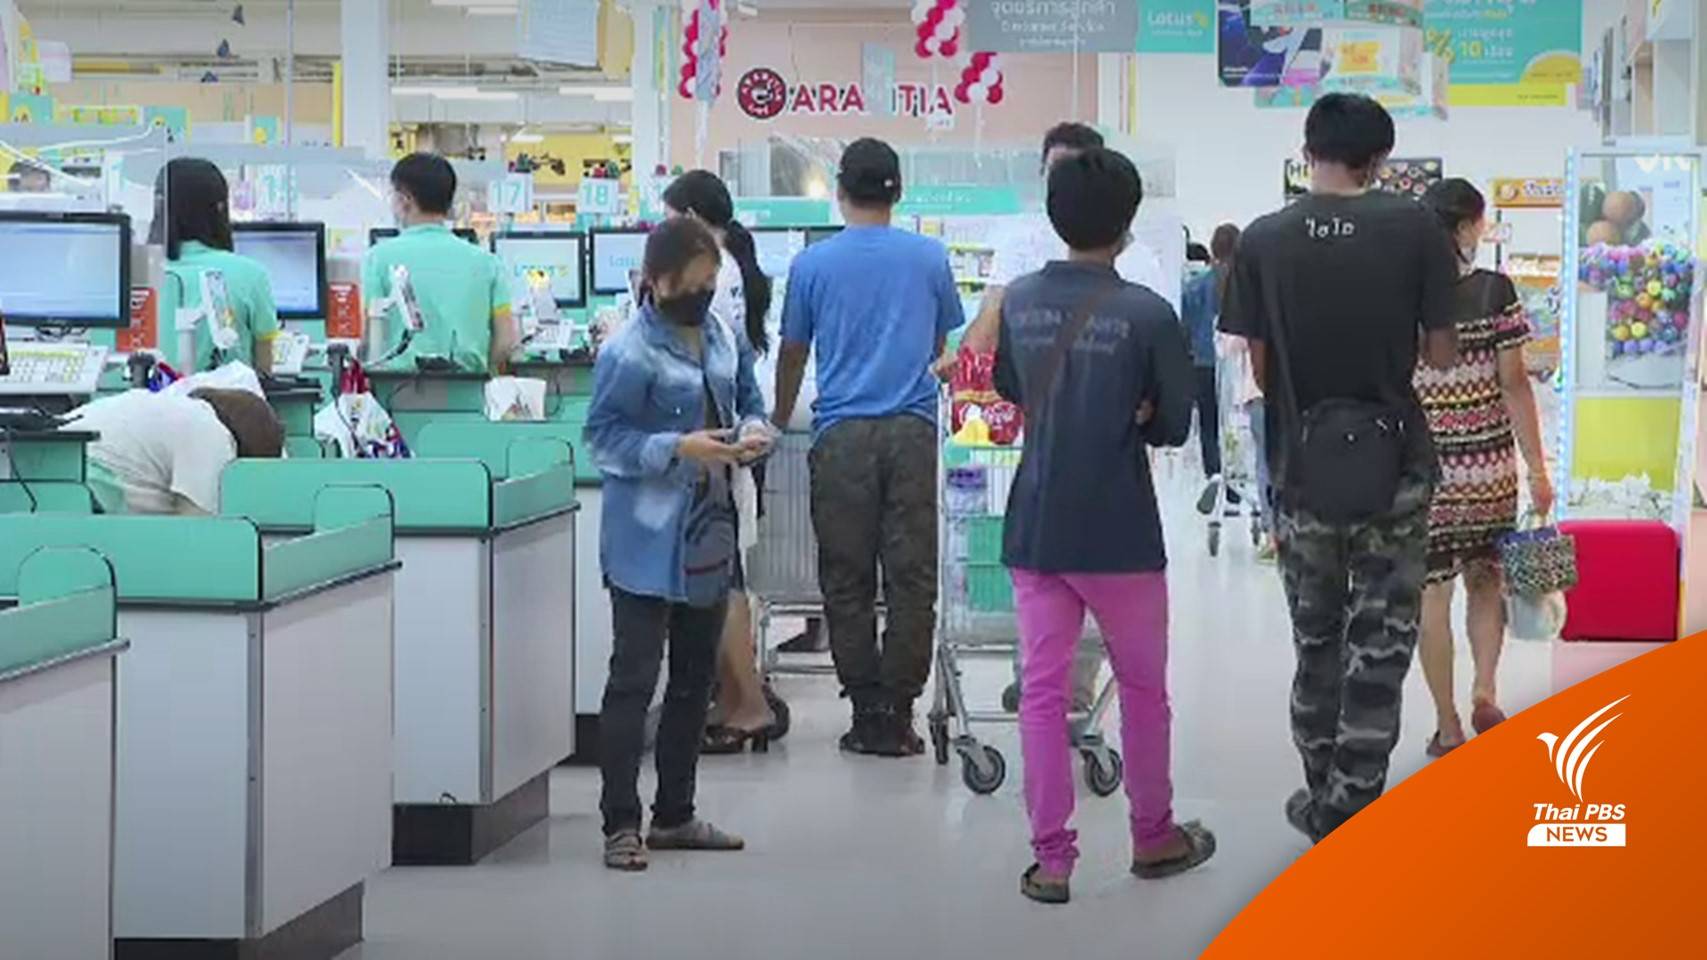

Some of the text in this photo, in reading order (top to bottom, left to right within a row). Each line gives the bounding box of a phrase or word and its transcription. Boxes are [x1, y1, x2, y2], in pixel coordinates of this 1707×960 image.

[791, 83, 953, 116] ARATIA
[494, 181, 523, 201] 17
[583, 183, 609, 205] 18
